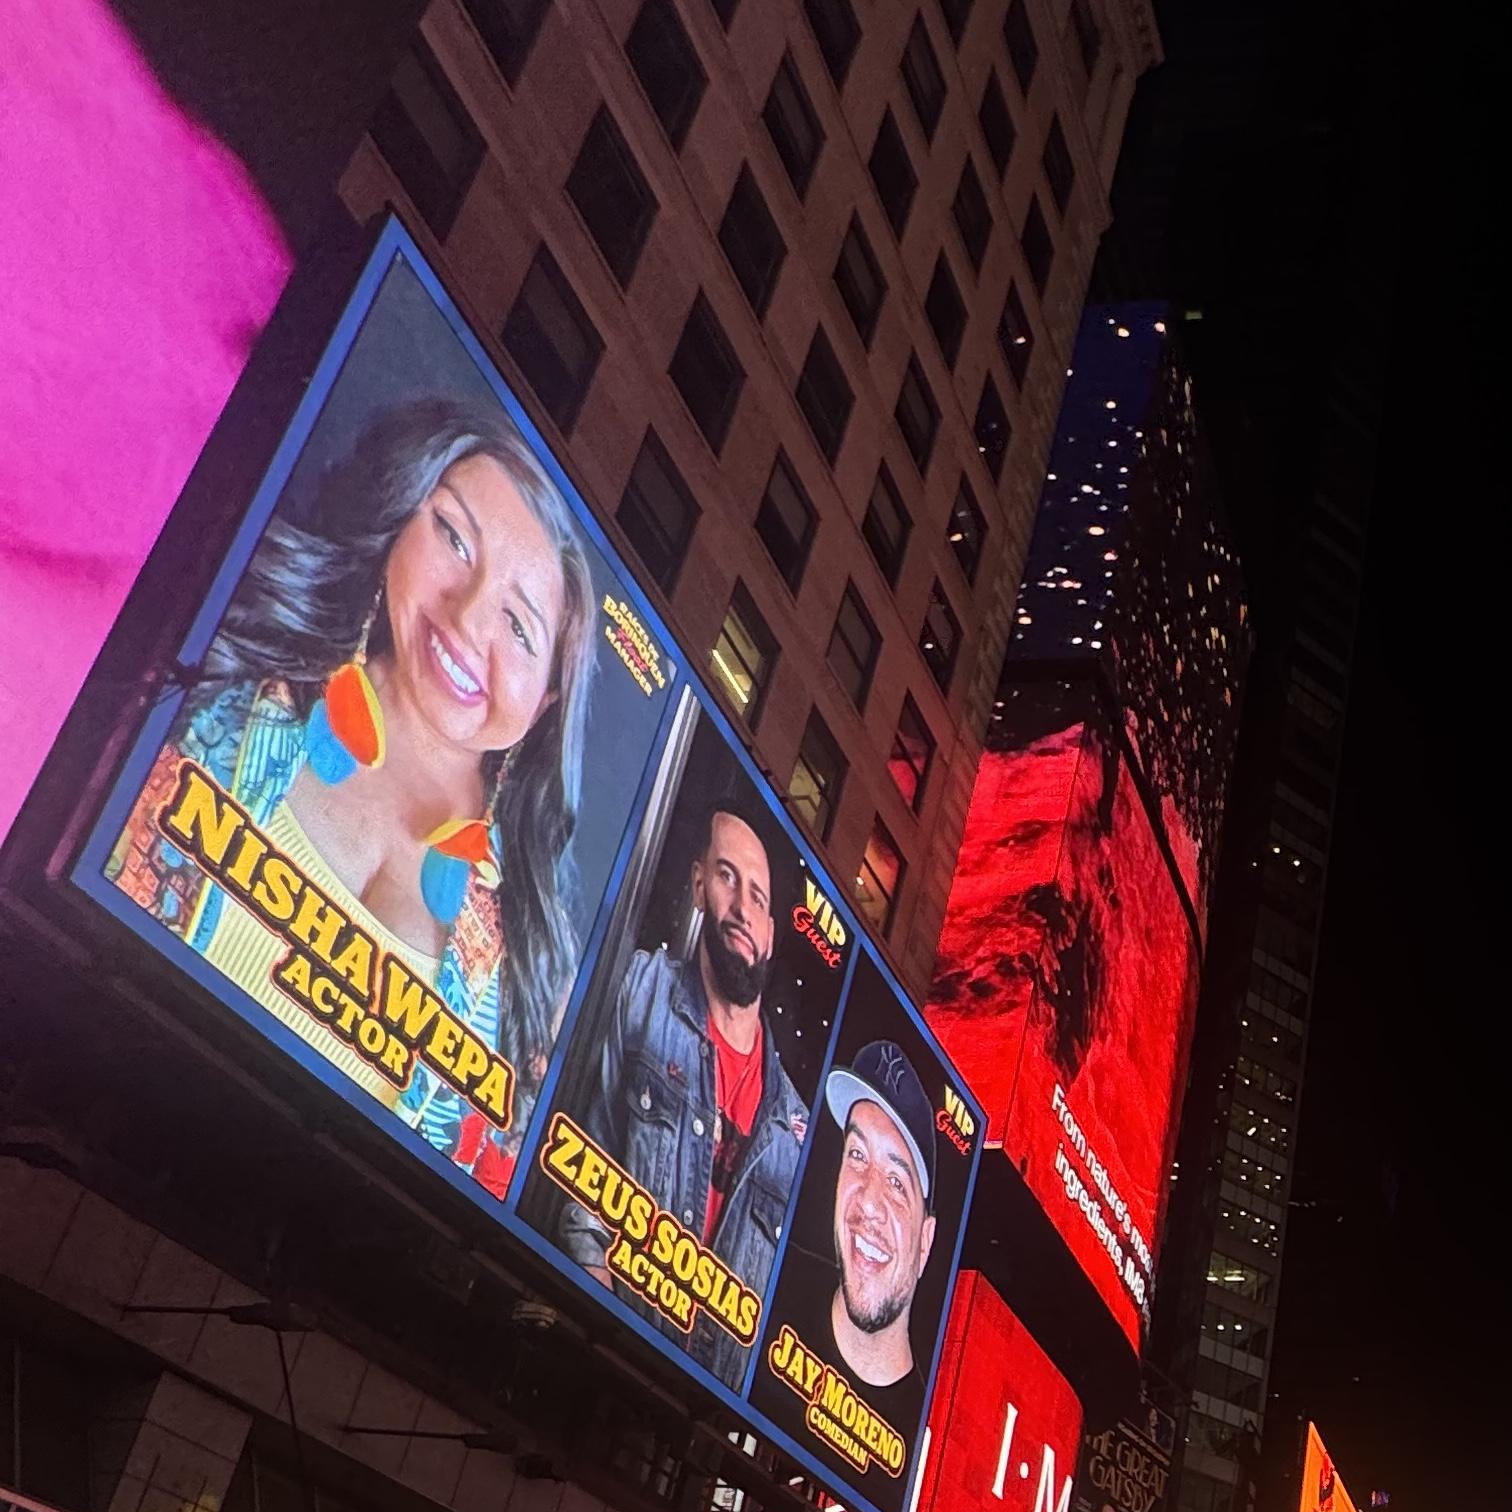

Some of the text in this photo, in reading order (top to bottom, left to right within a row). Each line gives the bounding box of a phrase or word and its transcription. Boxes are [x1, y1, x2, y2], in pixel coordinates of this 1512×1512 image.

[169, 770, 508, 1119] NISHA WEPA
[792, 904, 841, 969] Guest
[806, 877, 846, 946] VIP
[281, 956, 410, 1079] ACTOR
[936, 1109, 972, 1156] Guest
[944, 1083, 975, 1136] VIP
[1051, 1082, 1088, 1158] From
[1086, 1147, 1131, 1235] nature's
[548, 1122, 759, 1339] ZEUS SOSIAS
[1055, 1142, 1124, 1276] ingredients,
[612, 1242, 693, 1324] ACTOR
[772, 1331, 904, 1469] JAY MORENO
[810, 1406, 869, 1468] COMEDIAN
[1115, 1440, 1170, 1499] GREAT
